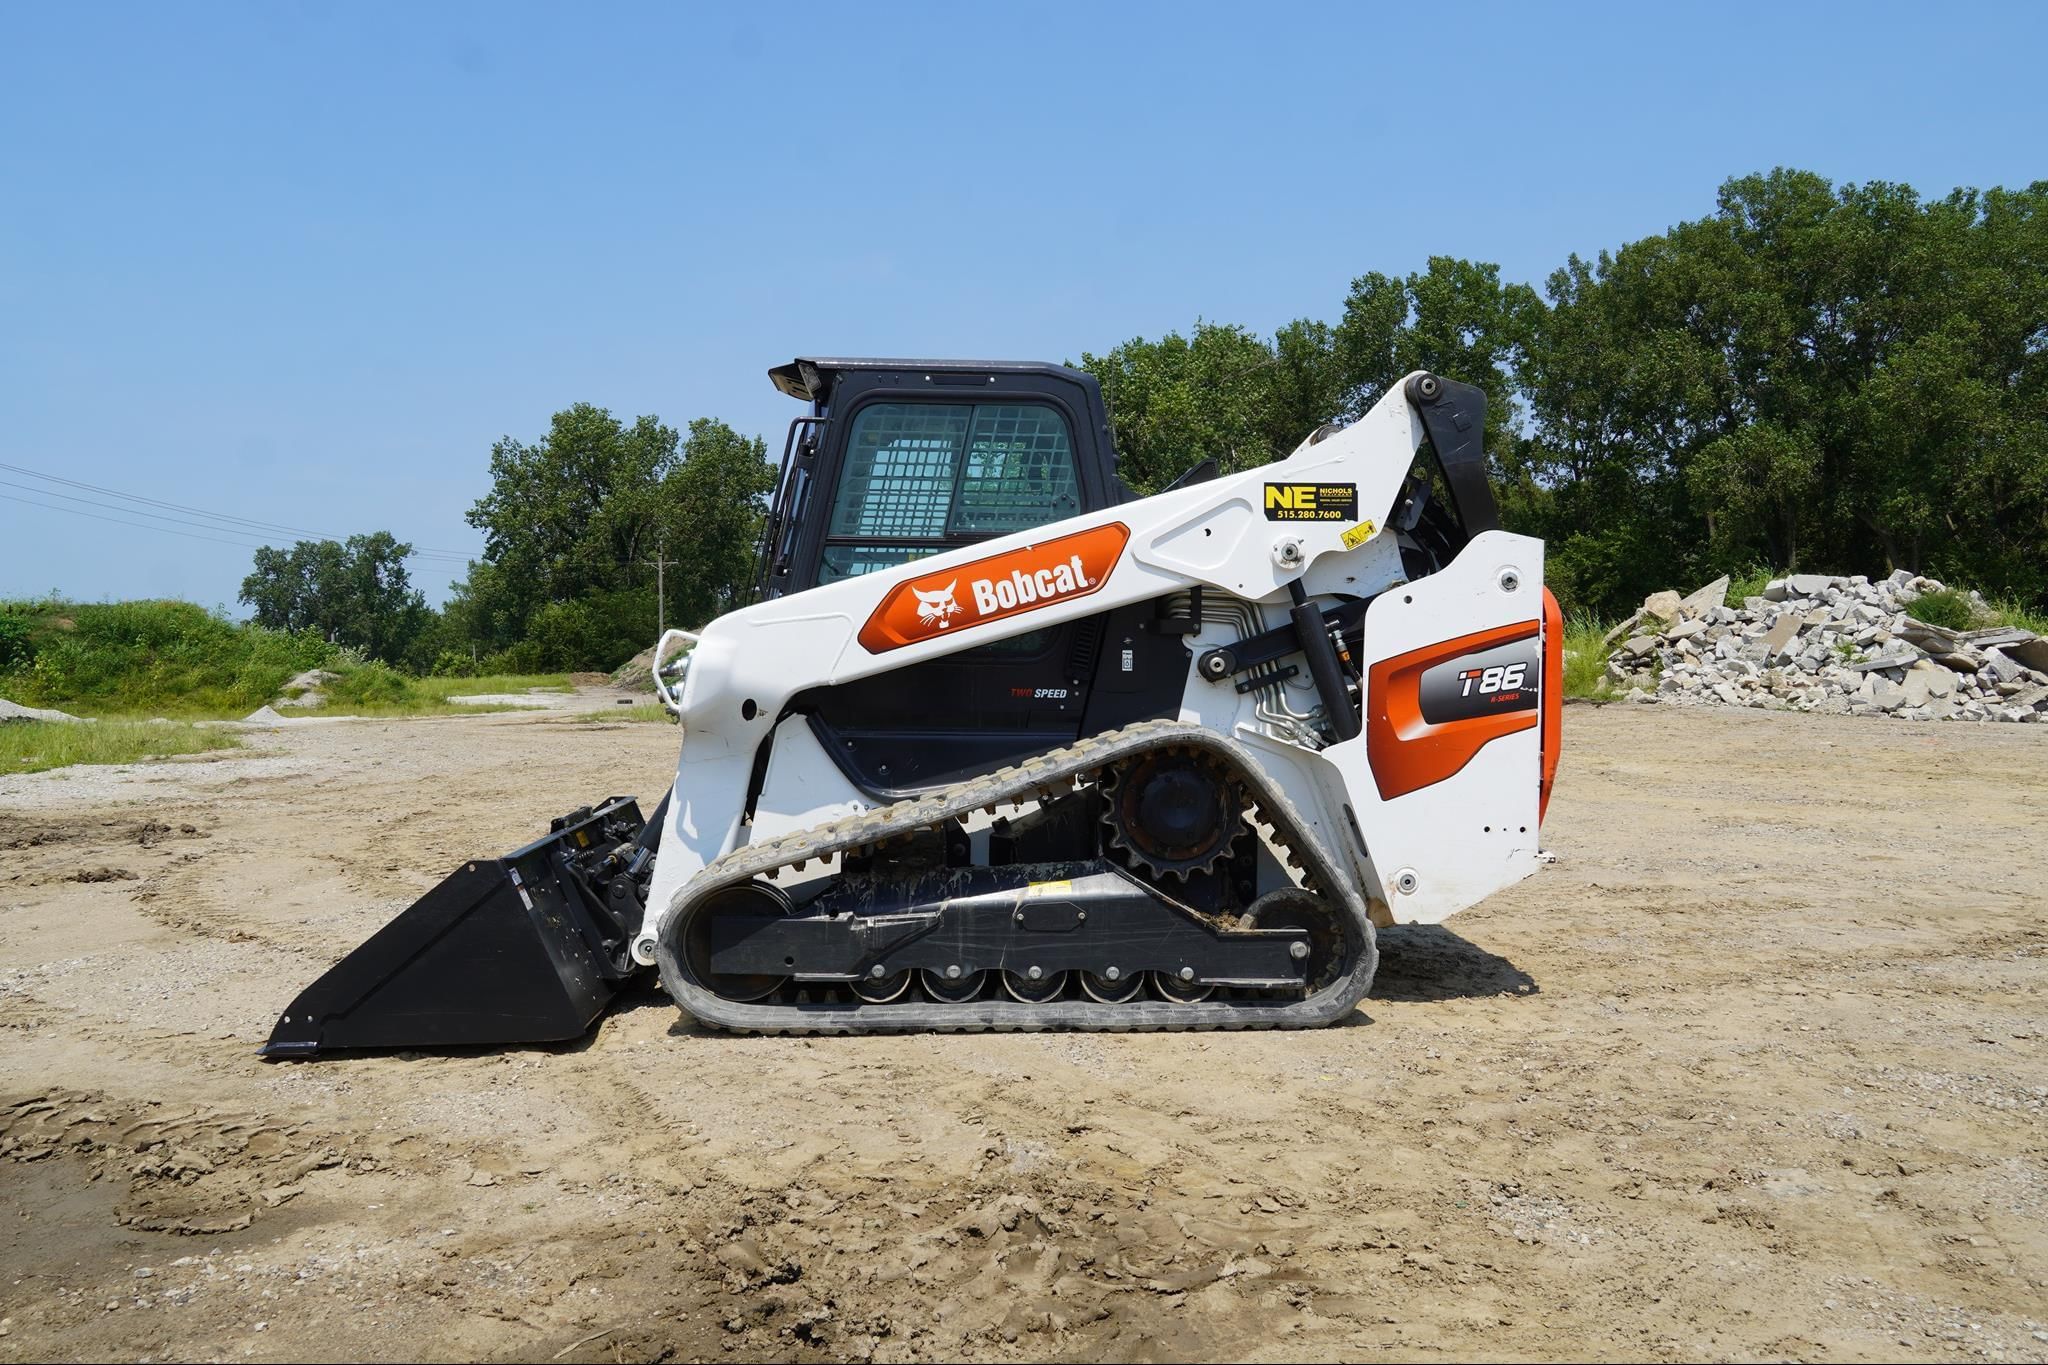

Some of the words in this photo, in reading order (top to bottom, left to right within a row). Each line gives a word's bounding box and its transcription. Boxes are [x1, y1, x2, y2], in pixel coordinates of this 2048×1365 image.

[1265, 486, 1317, 509] NE
[1277, 510, 1342, 519] 515.280.7600
[1459, 662, 1527, 697] T86
[1010, 688, 1033, 697] TWO
[1034, 688, 1068, 698] SPEED
